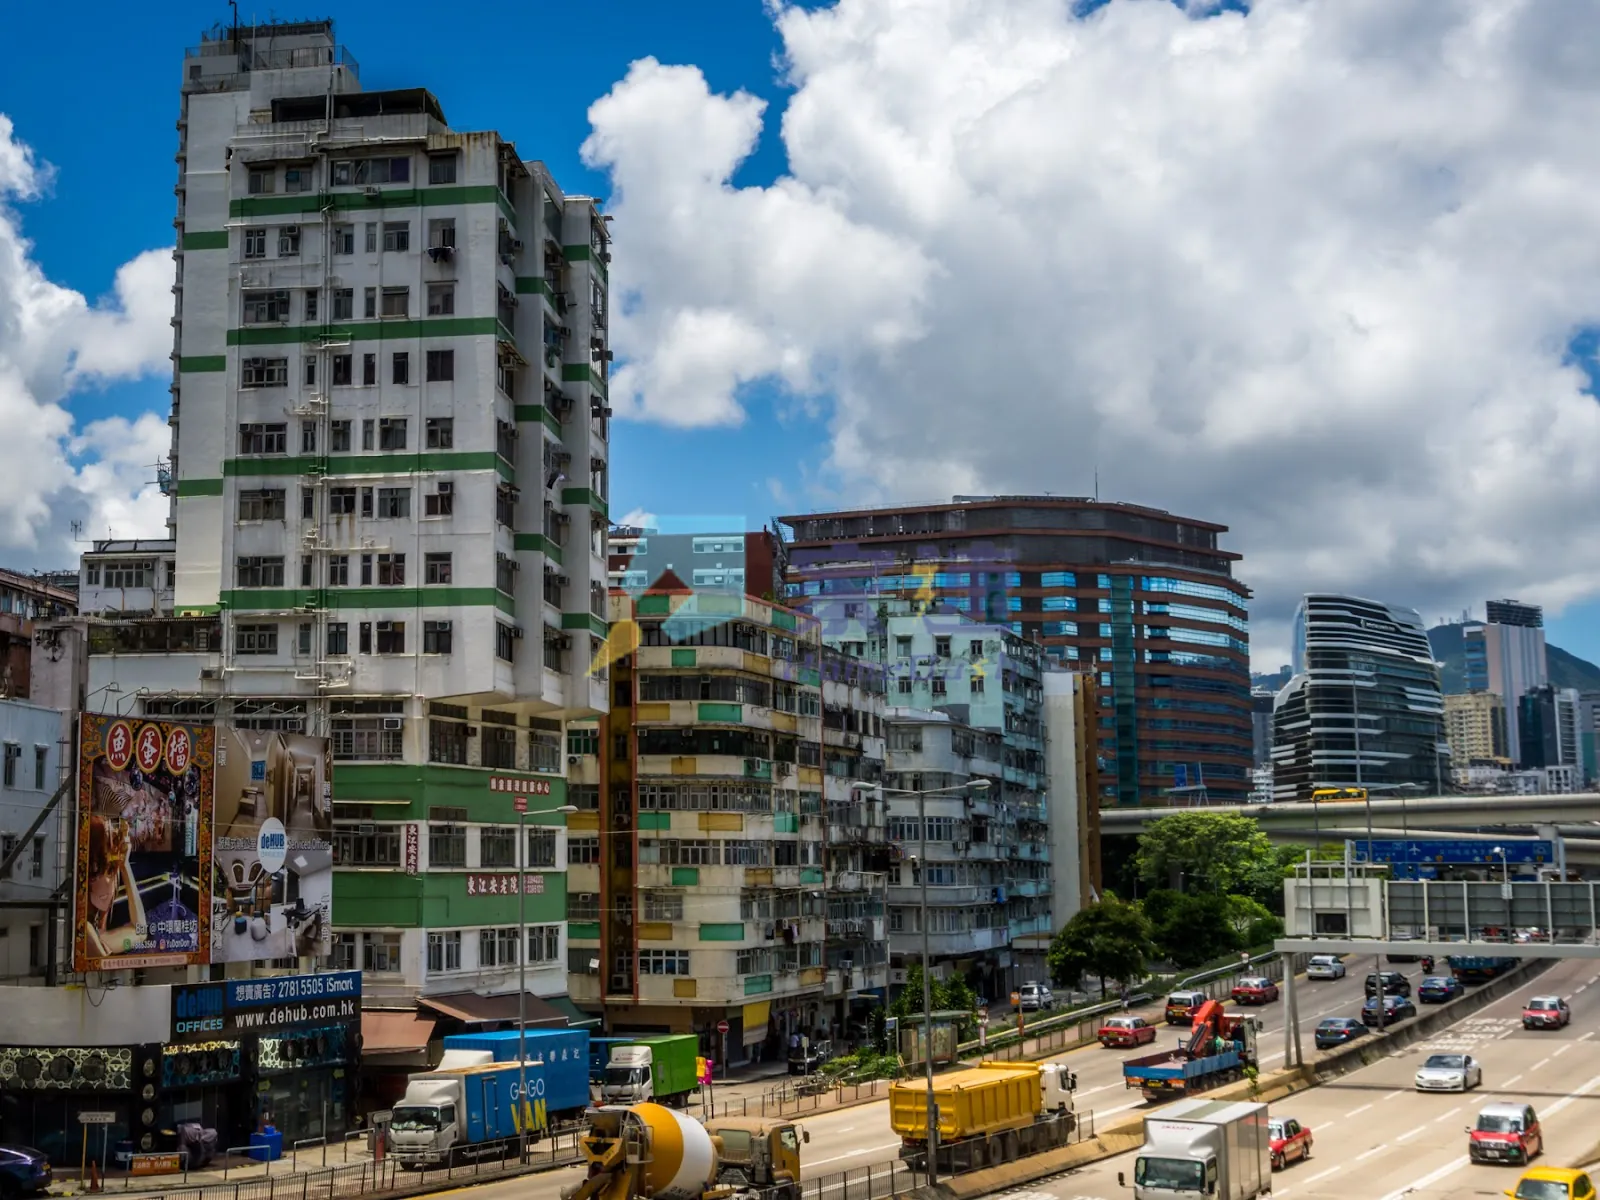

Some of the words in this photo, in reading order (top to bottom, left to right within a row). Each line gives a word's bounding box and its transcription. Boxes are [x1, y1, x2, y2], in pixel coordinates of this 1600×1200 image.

[111, 726, 188, 767] 魚蛋檔
[407, 824, 417, 875] 東江安老院
[467, 875, 519, 895] 東江安老院
[326, 977, 354, 991] iSmart
[176, 1018, 224, 1033] OFFICES
[235, 1000, 355, 1028] www.dehub.com.hk
